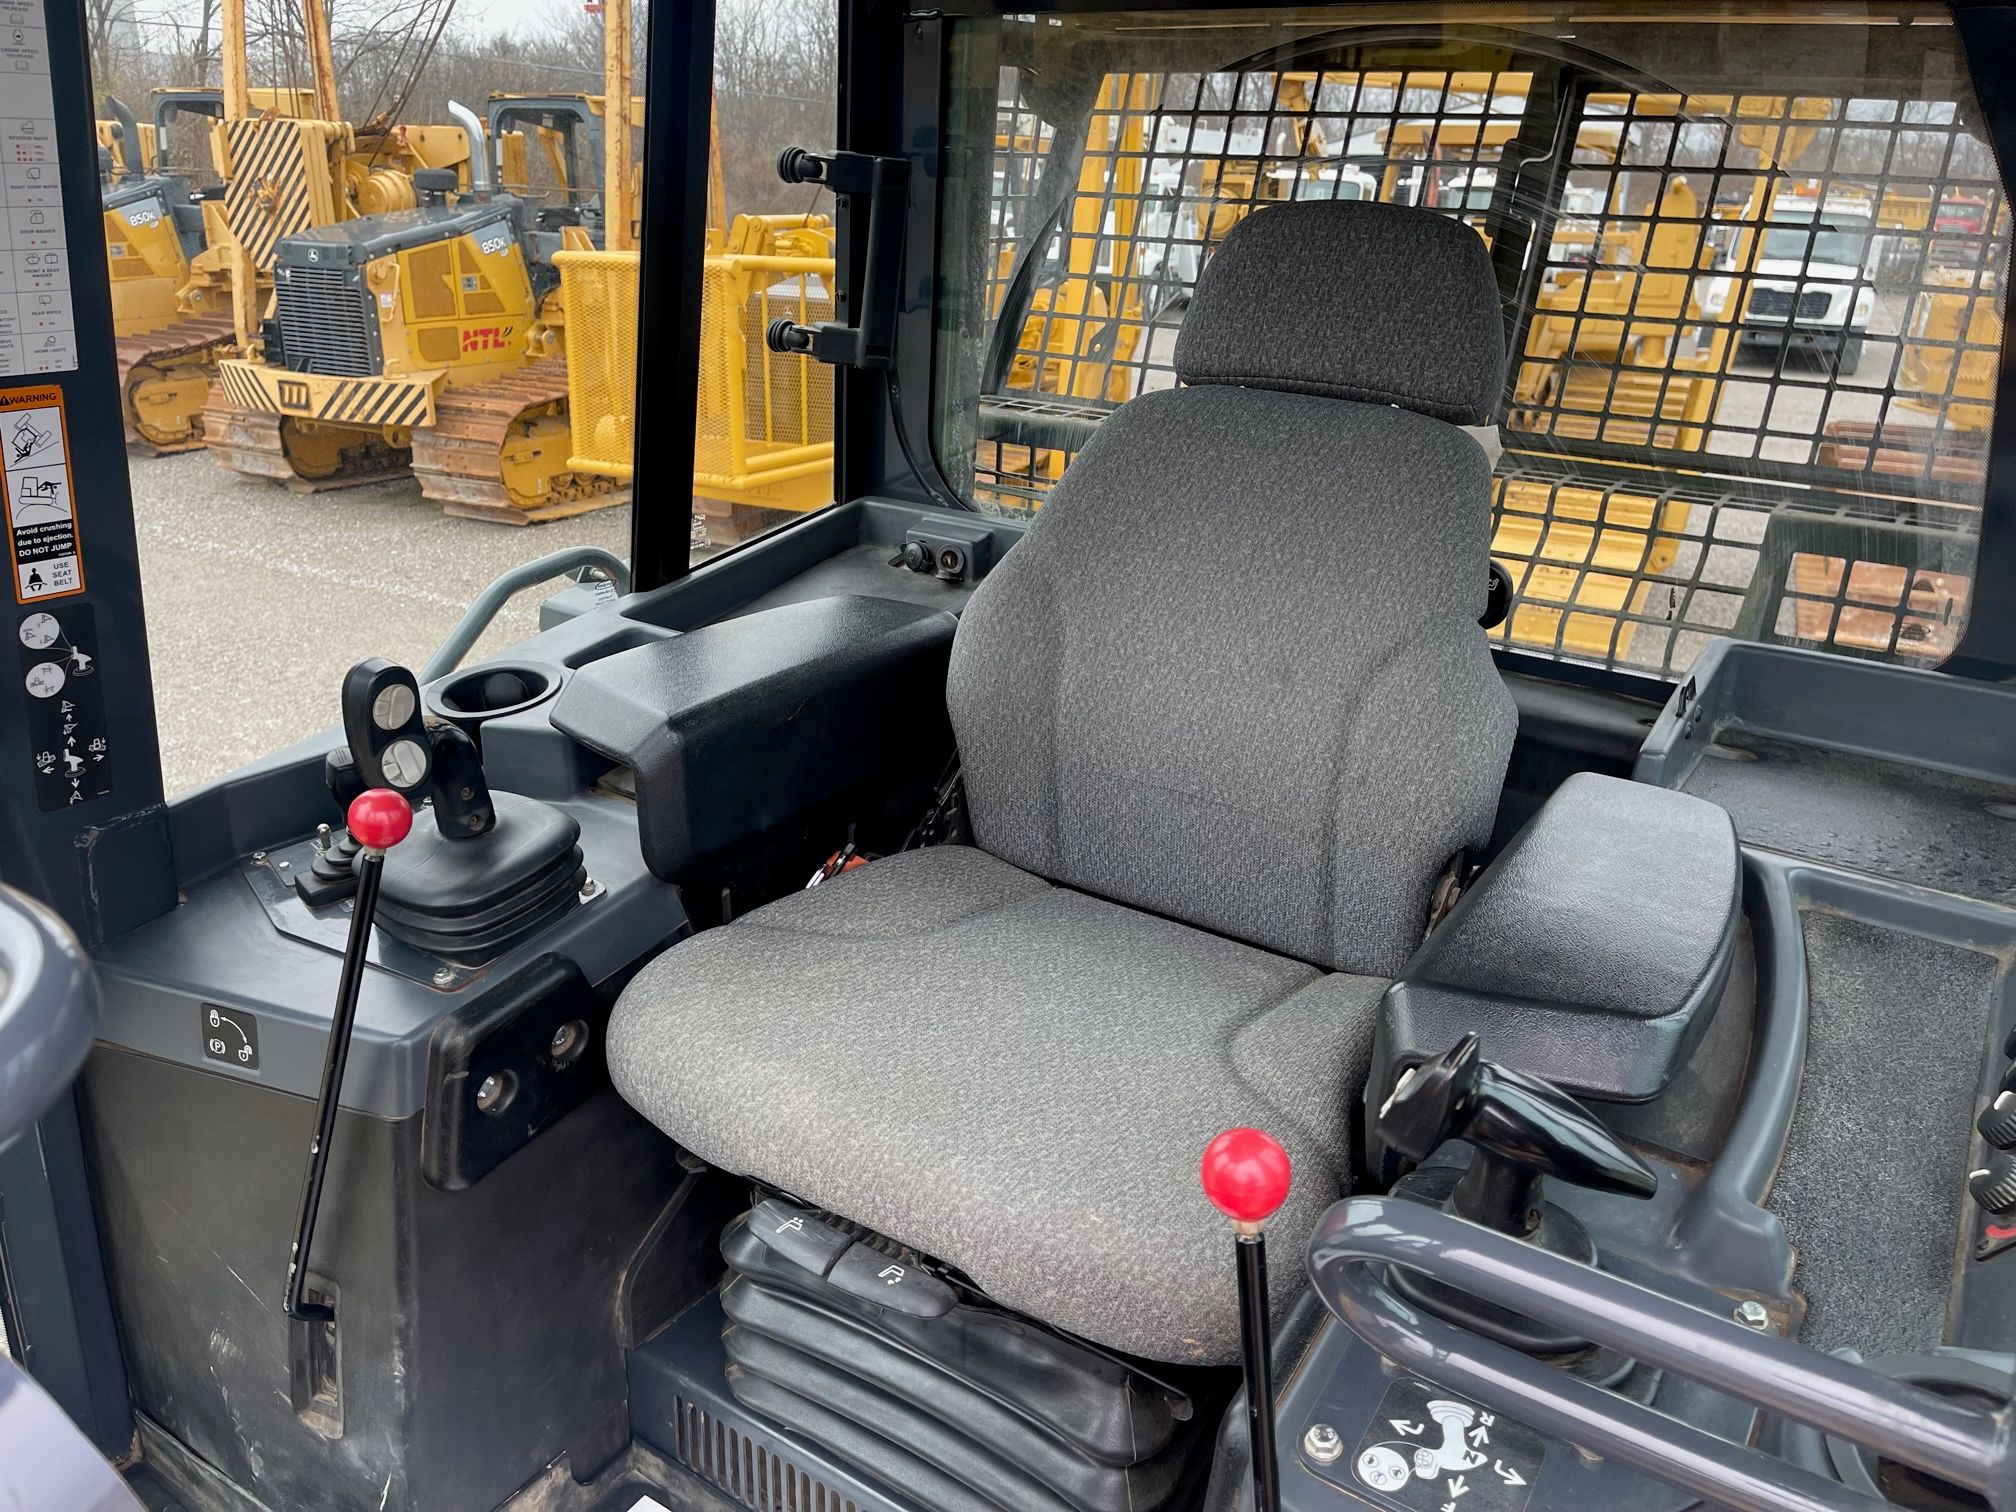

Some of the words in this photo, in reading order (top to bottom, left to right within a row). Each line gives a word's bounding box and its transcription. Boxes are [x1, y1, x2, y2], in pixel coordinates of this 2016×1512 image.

[129, 211, 156, 226] 850K
[481, 237, 507, 255] 850K
[9, 392, 57, 404] WARNING
[16, 527, 38, 537] Avoid
[39, 522, 73, 532] crushing
[42, 533, 74, 543] ejection.
[18, 549, 31, 557] DO
[32, 546, 49, 555] NOT
[50, 542, 73, 552] JUMP
[53, 561, 69, 570] USE
[52, 569, 72, 579] SEAT
[53, 577, 73, 587] BELT
